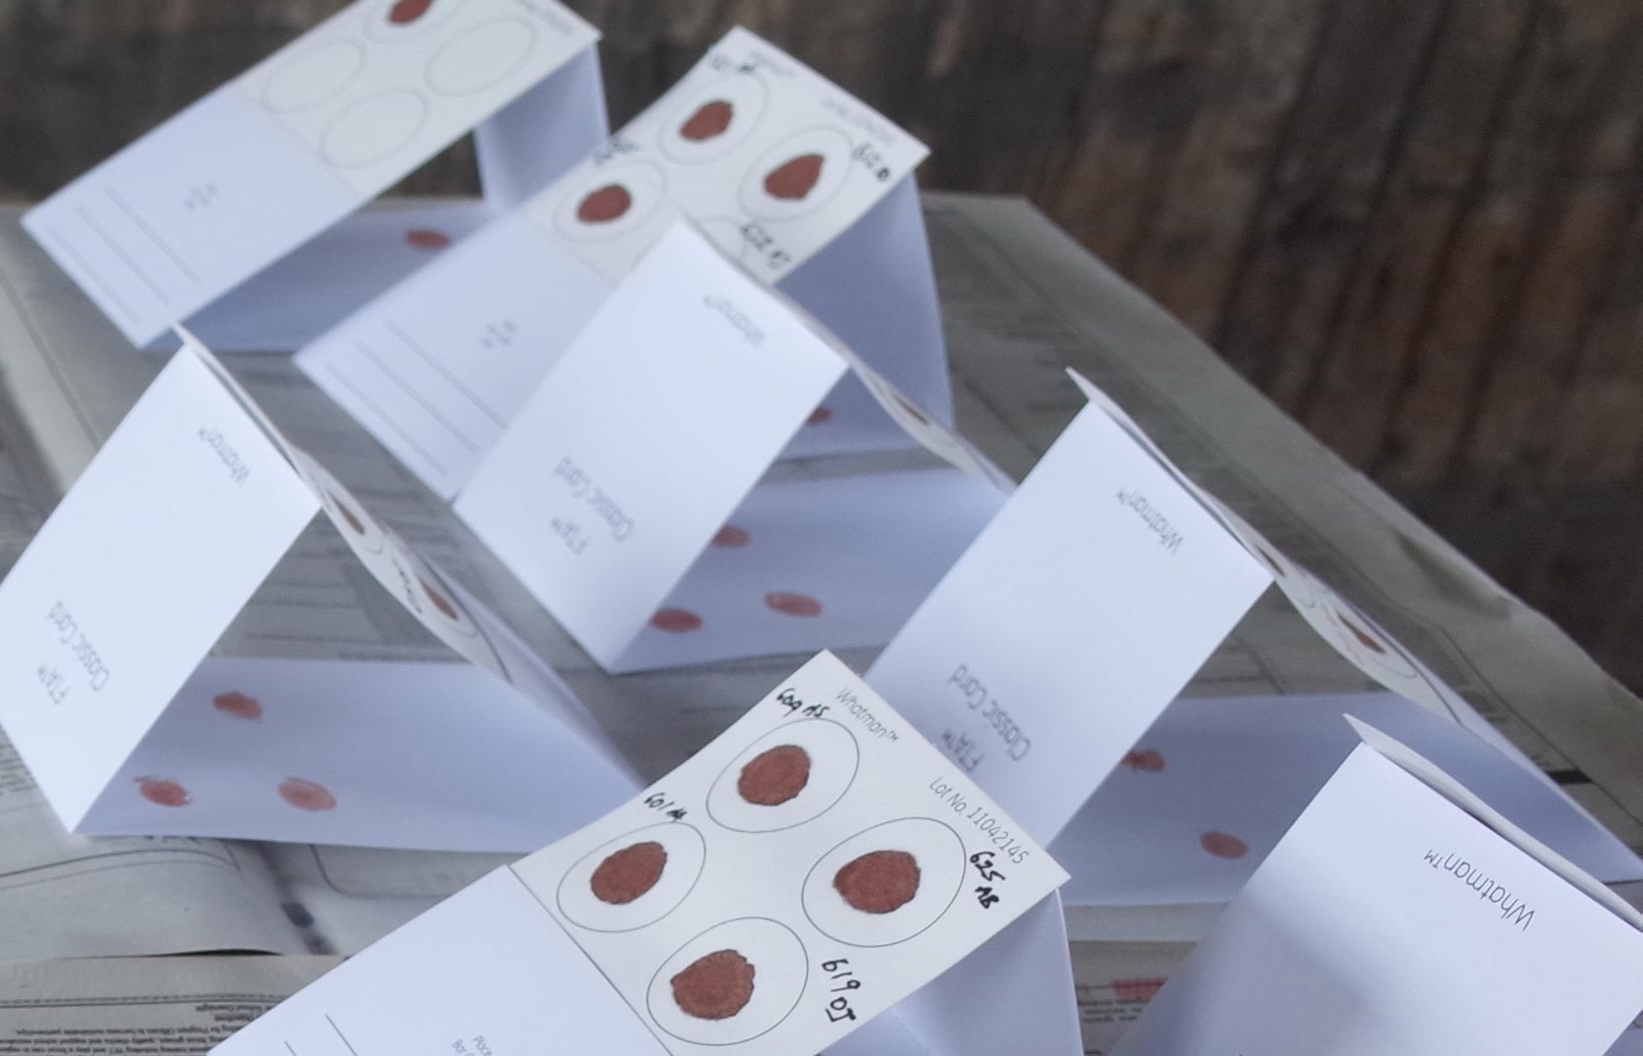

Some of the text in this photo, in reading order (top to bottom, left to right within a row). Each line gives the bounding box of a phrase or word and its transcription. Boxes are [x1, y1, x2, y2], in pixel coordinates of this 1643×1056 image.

[948, 664, 1032, 762] Classic Card
[928, 776, 1031, 865] Lot No. 11042145
[969, 850, 1005, 886] 625
[822, 958, 861, 991] 619
